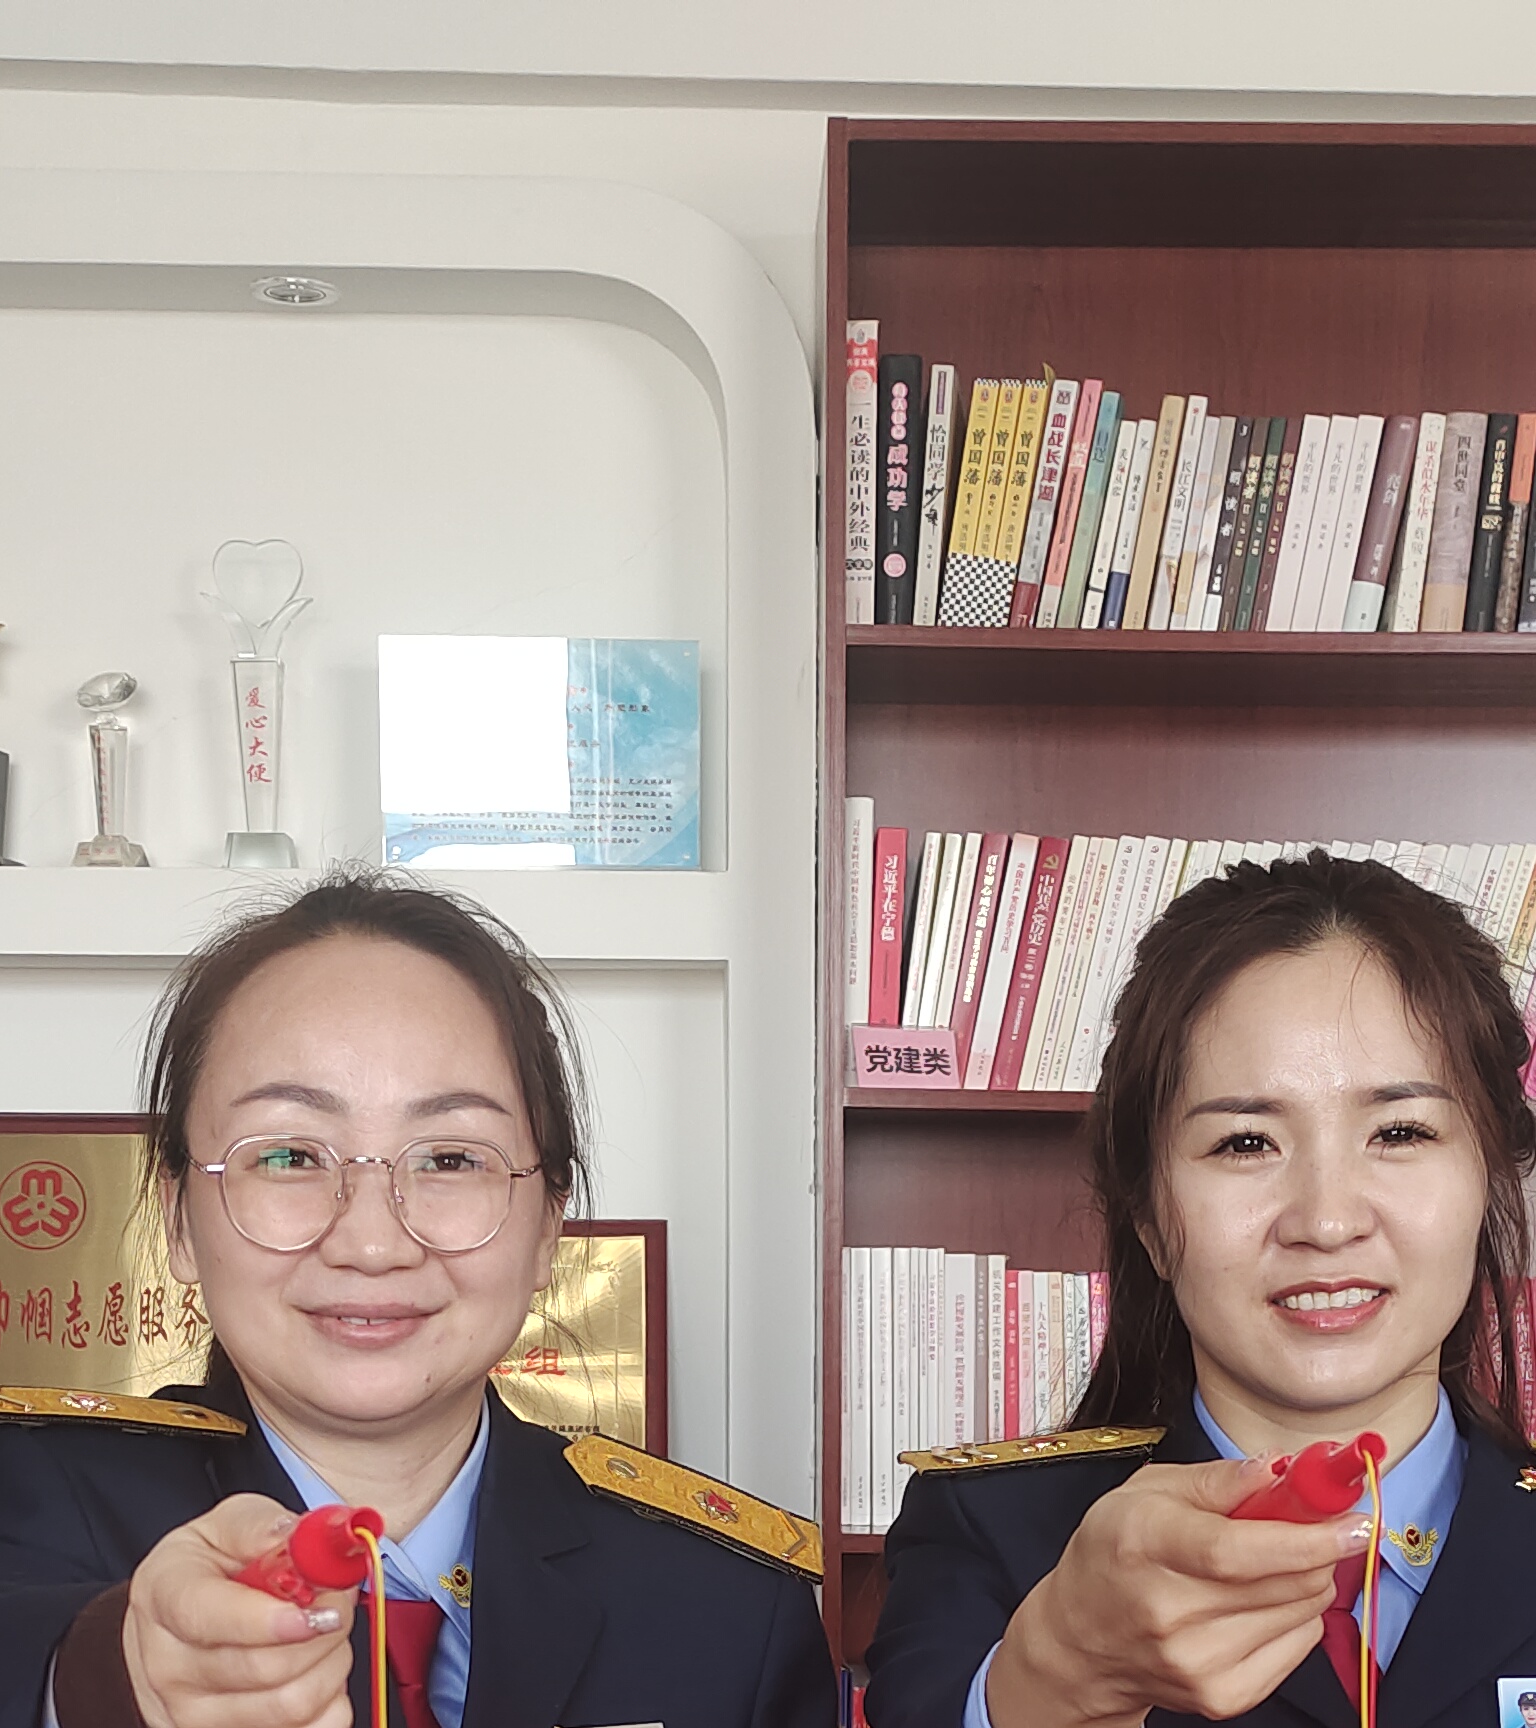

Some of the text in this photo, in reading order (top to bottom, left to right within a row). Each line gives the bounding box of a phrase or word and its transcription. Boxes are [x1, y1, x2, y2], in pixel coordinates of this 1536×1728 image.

[848, 402, 872, 552] 一生必读的中外经典
[886, 443, 909, 512] 成功学
[922, 423, 945, 536] 恰同学少年
[964, 429, 986, 486] 曾国藩
[988, 429, 1009, 487] 曾国藩
[1011, 430, 1034, 487] 曾国藩
[1038, 413, 1066, 501] 血战长津湖
[1454, 436, 1471, 492] 四世同堂
[880, 854, 898, 942] 习近平在宁德
[1028, 874, 1055, 946] 中国共产党历史
[864, 1046, 952, 1077] 党建类
